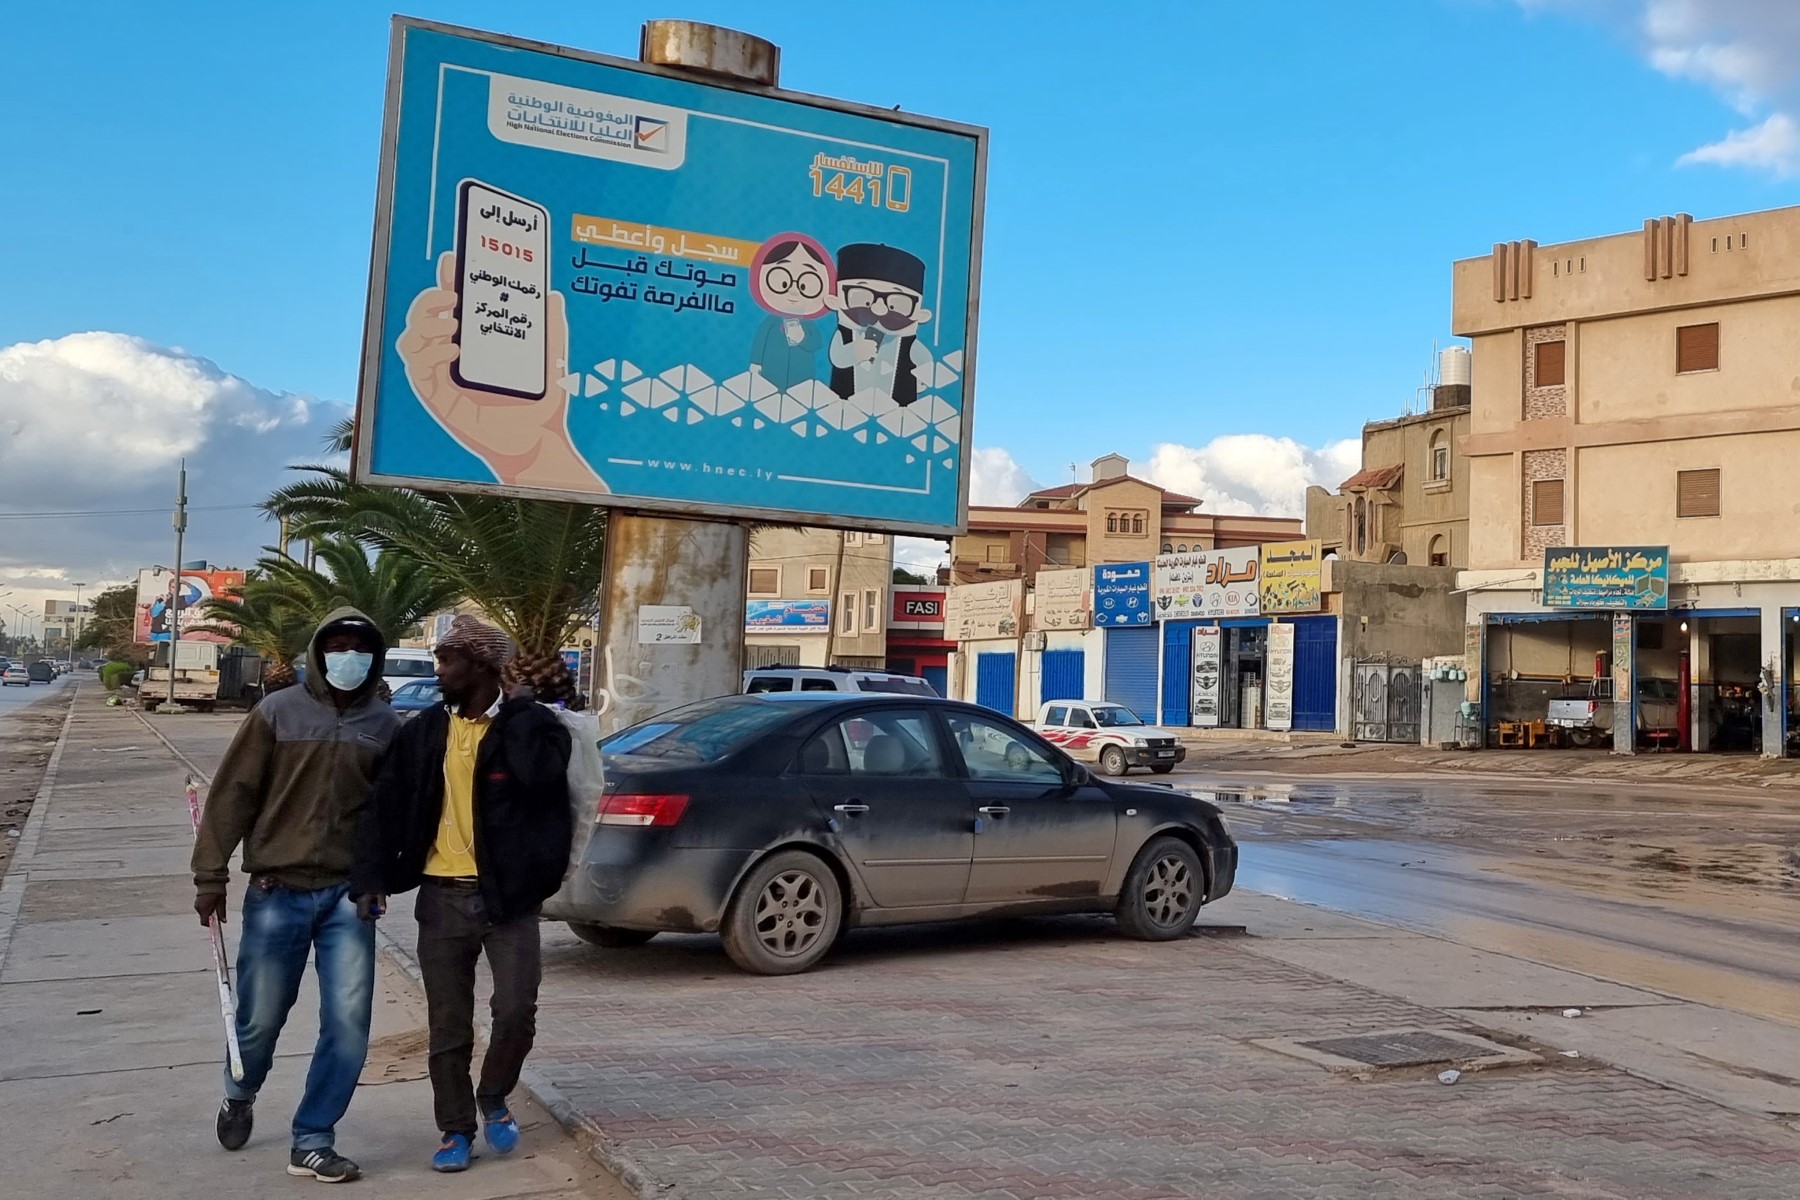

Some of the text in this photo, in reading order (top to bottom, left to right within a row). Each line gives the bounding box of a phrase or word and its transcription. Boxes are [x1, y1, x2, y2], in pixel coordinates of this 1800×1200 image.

[507, 92, 634, 126] المفوضية الوطنية
[506, 120, 632, 149] High National Elections Commission
[507, 108, 633, 141] العليا للانتخابات
[809, 168, 881, 207] 1441
[480, 204, 538, 232] أرسل إلى
[481, 235, 534, 263] 15015
[469, 269, 541, 299] رقمك الوطني
[571, 276, 638, 302] تفوتك
[475, 302, 532, 328] رقم المركز
[480, 322, 526, 340] الانتخابي
[647, 459, 773, 481] www.hnec.ly
[1206, 556, 1257, 588] مراد
[1622, 551, 1662, 572] مركز
[906, 601, 938, 615] FASI
